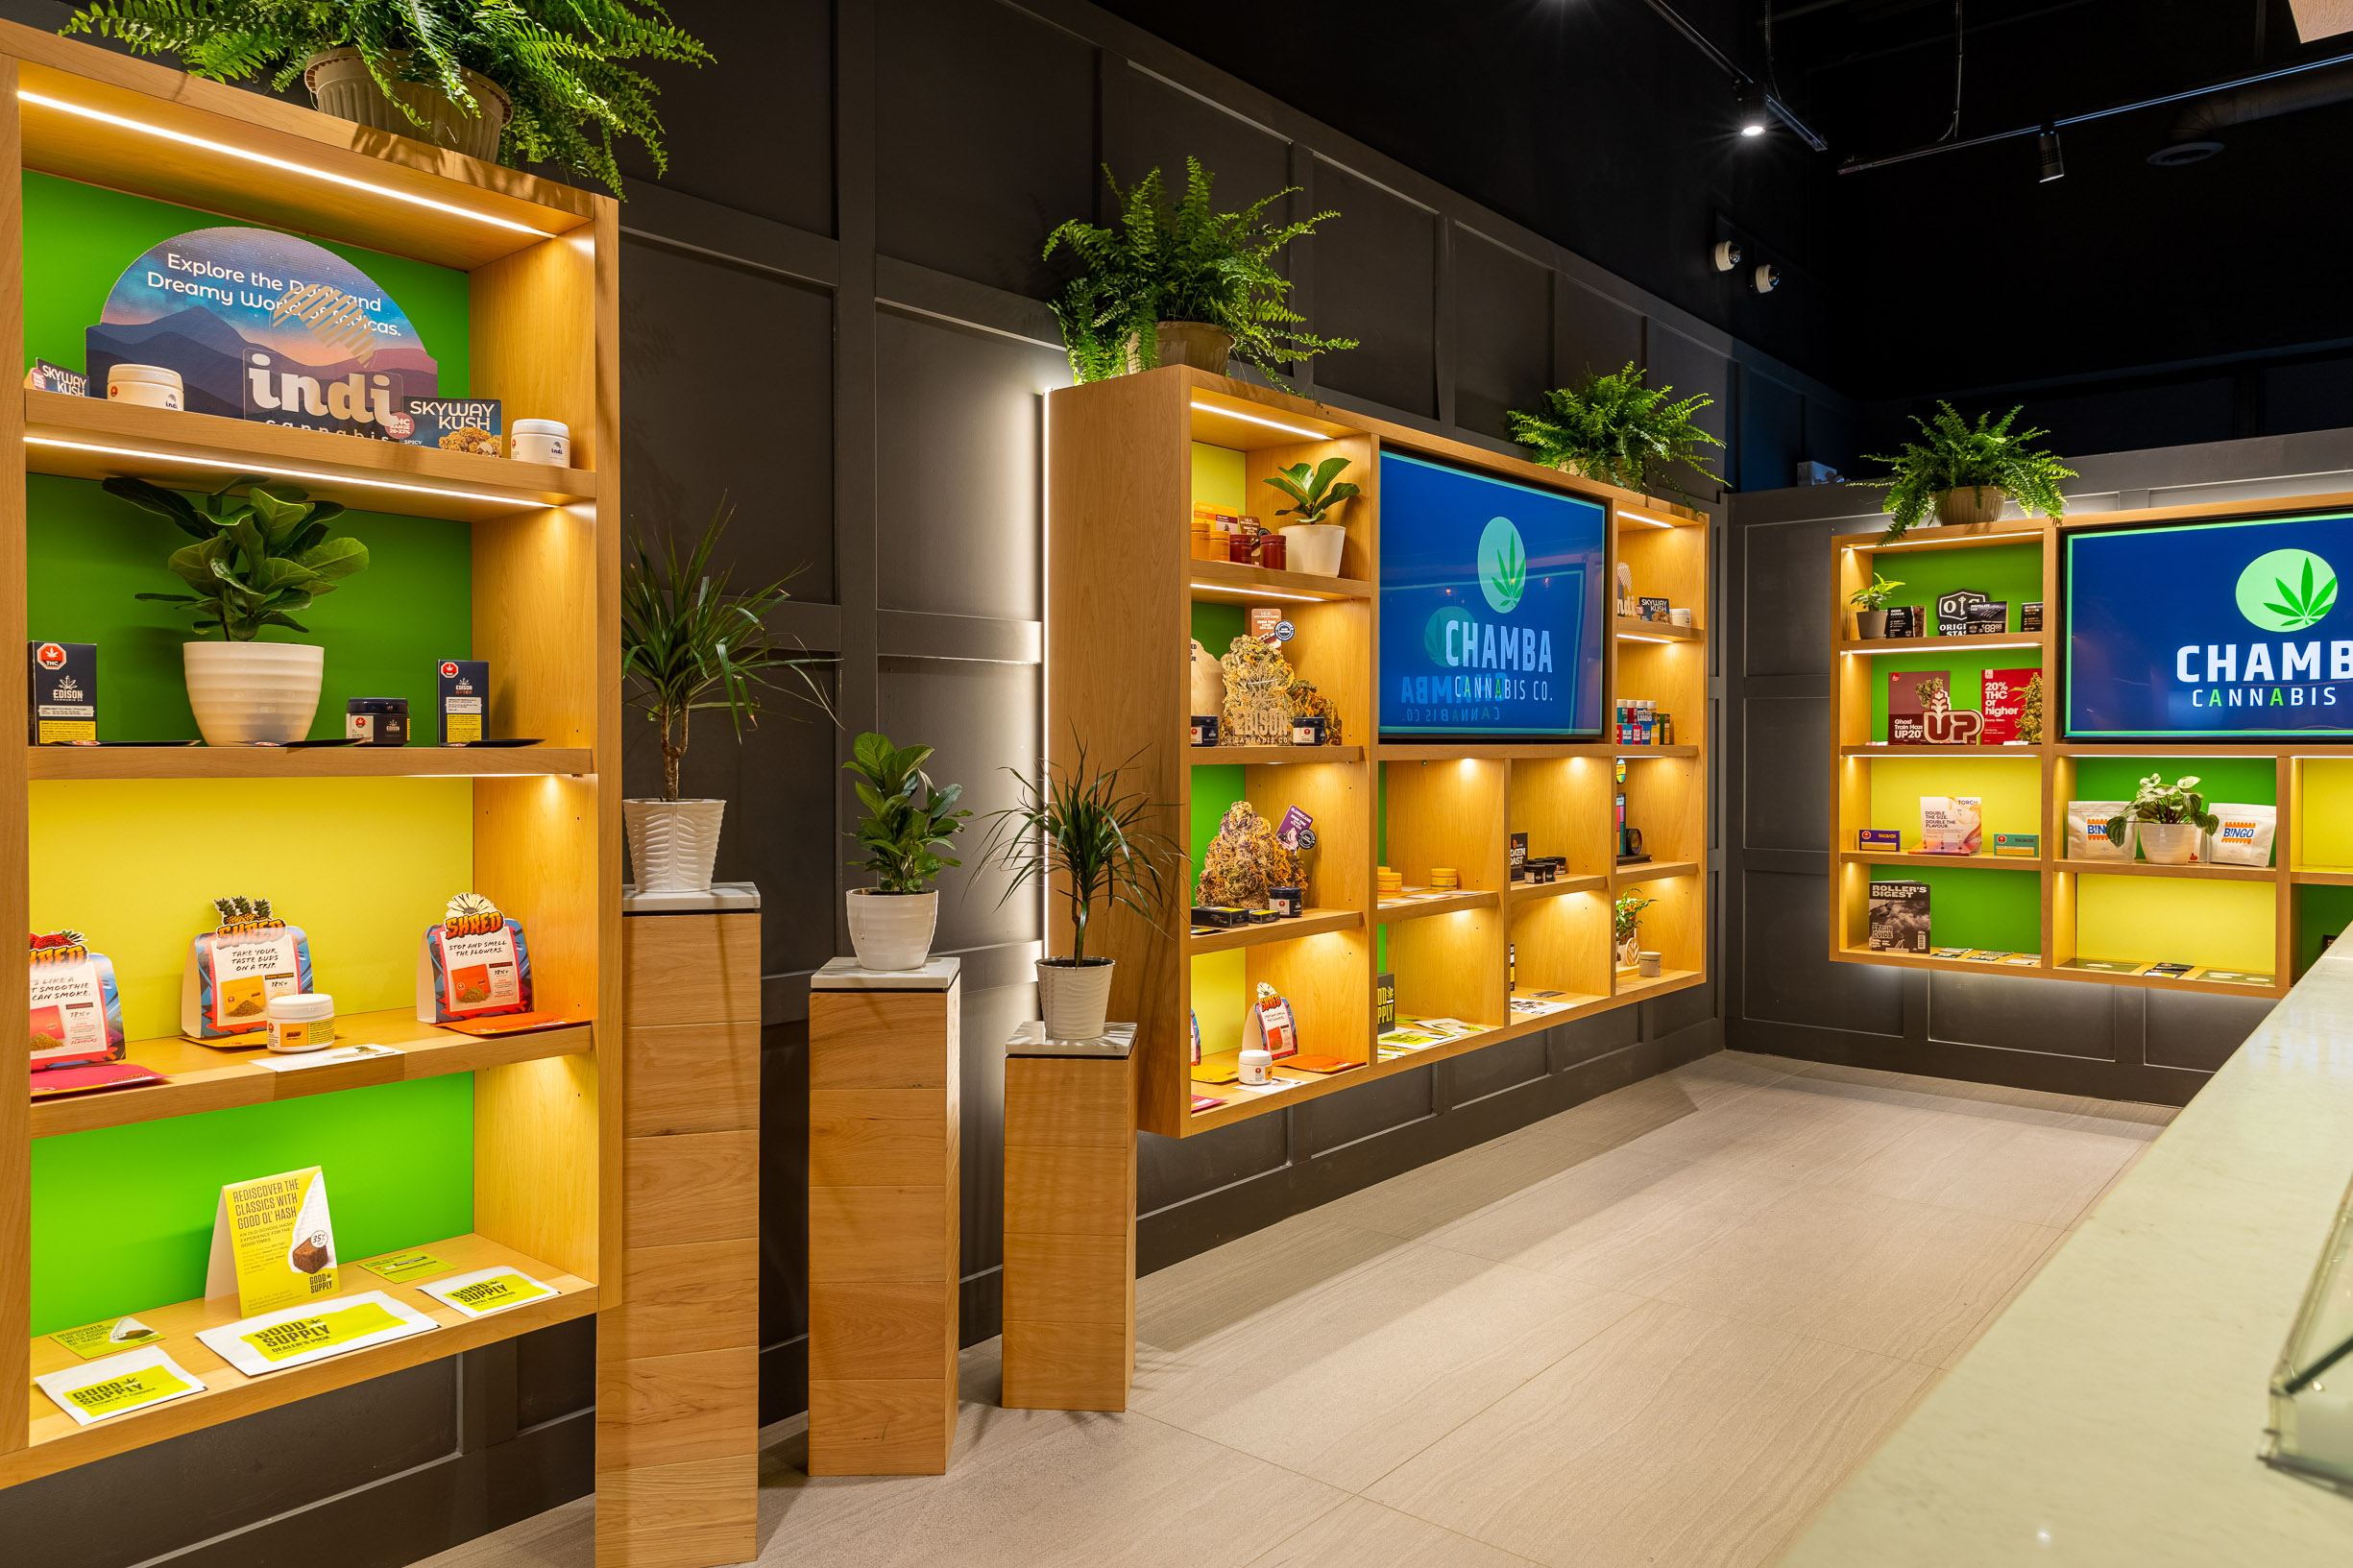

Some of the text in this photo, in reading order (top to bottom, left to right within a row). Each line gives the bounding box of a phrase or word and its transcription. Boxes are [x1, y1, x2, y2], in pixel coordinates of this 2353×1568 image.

[148, 271, 233, 306] Dreamy
[167, 253, 245, 283] Explore
[251, 272, 283, 291] the
[347, 295, 381, 312] and
[42, 364, 86, 389] SKYWAY
[57, 381, 85, 397] KUSH
[249, 352, 399, 426] indi
[410, 400, 495, 418] SKYWAY
[438, 416, 491, 432] KUSH
[1445, 619, 1553, 673] CHAMBA
[53, 689, 84, 699] EDISON
[1455, 675, 1552, 701] CANNABIS CO.
[1985, 682, 2008, 691] 20%
[1985, 691, 2008, 699] THC
[2192, 687, 2337, 707] CANNABIS
[1985, 706, 2018, 717] higher
[1234, 709, 1287, 735] EDISON
[1923, 711, 1982, 744] UP
[1872, 885, 1927, 893] ROLLER'S
[217, 919, 285, 947] SHRED
[446, 912, 503, 940] SHRED
[470, 948, 503, 956] FLOWERS.
[40, 983, 89, 993] SMOOTHIE
[42, 977, 66, 985] LIKE
[55, 989, 91, 1000] SMOKE.
[1260, 993, 1281, 1012] SHRED
[233, 1179, 299, 1203] REDISCOVER THE
[235, 1192, 297, 1216] CLASSICS WITH
[238, 1214, 260, 1230] GOOD
[275, 1206, 296, 1221] HASH
[240, 1233, 270, 1243] EXPERIENCE
[247, 1225, 278, 1236] OLD-SCHOOL
[310, 1274, 326, 1285] GOOD
[311, 1281, 332, 1294] SUPPLY
[452, 1283, 489, 1297] GOOD
[460, 1284, 508, 1302] SUPPLY
[255, 1322, 307, 1339] GOOD
[262, 1325, 330, 1347] SUPPLY
[272, 1341, 310, 1352] DEALER'S
[73, 1382, 121, 1399] GOOD
[79, 1383, 143, 1405] SUPPLY
